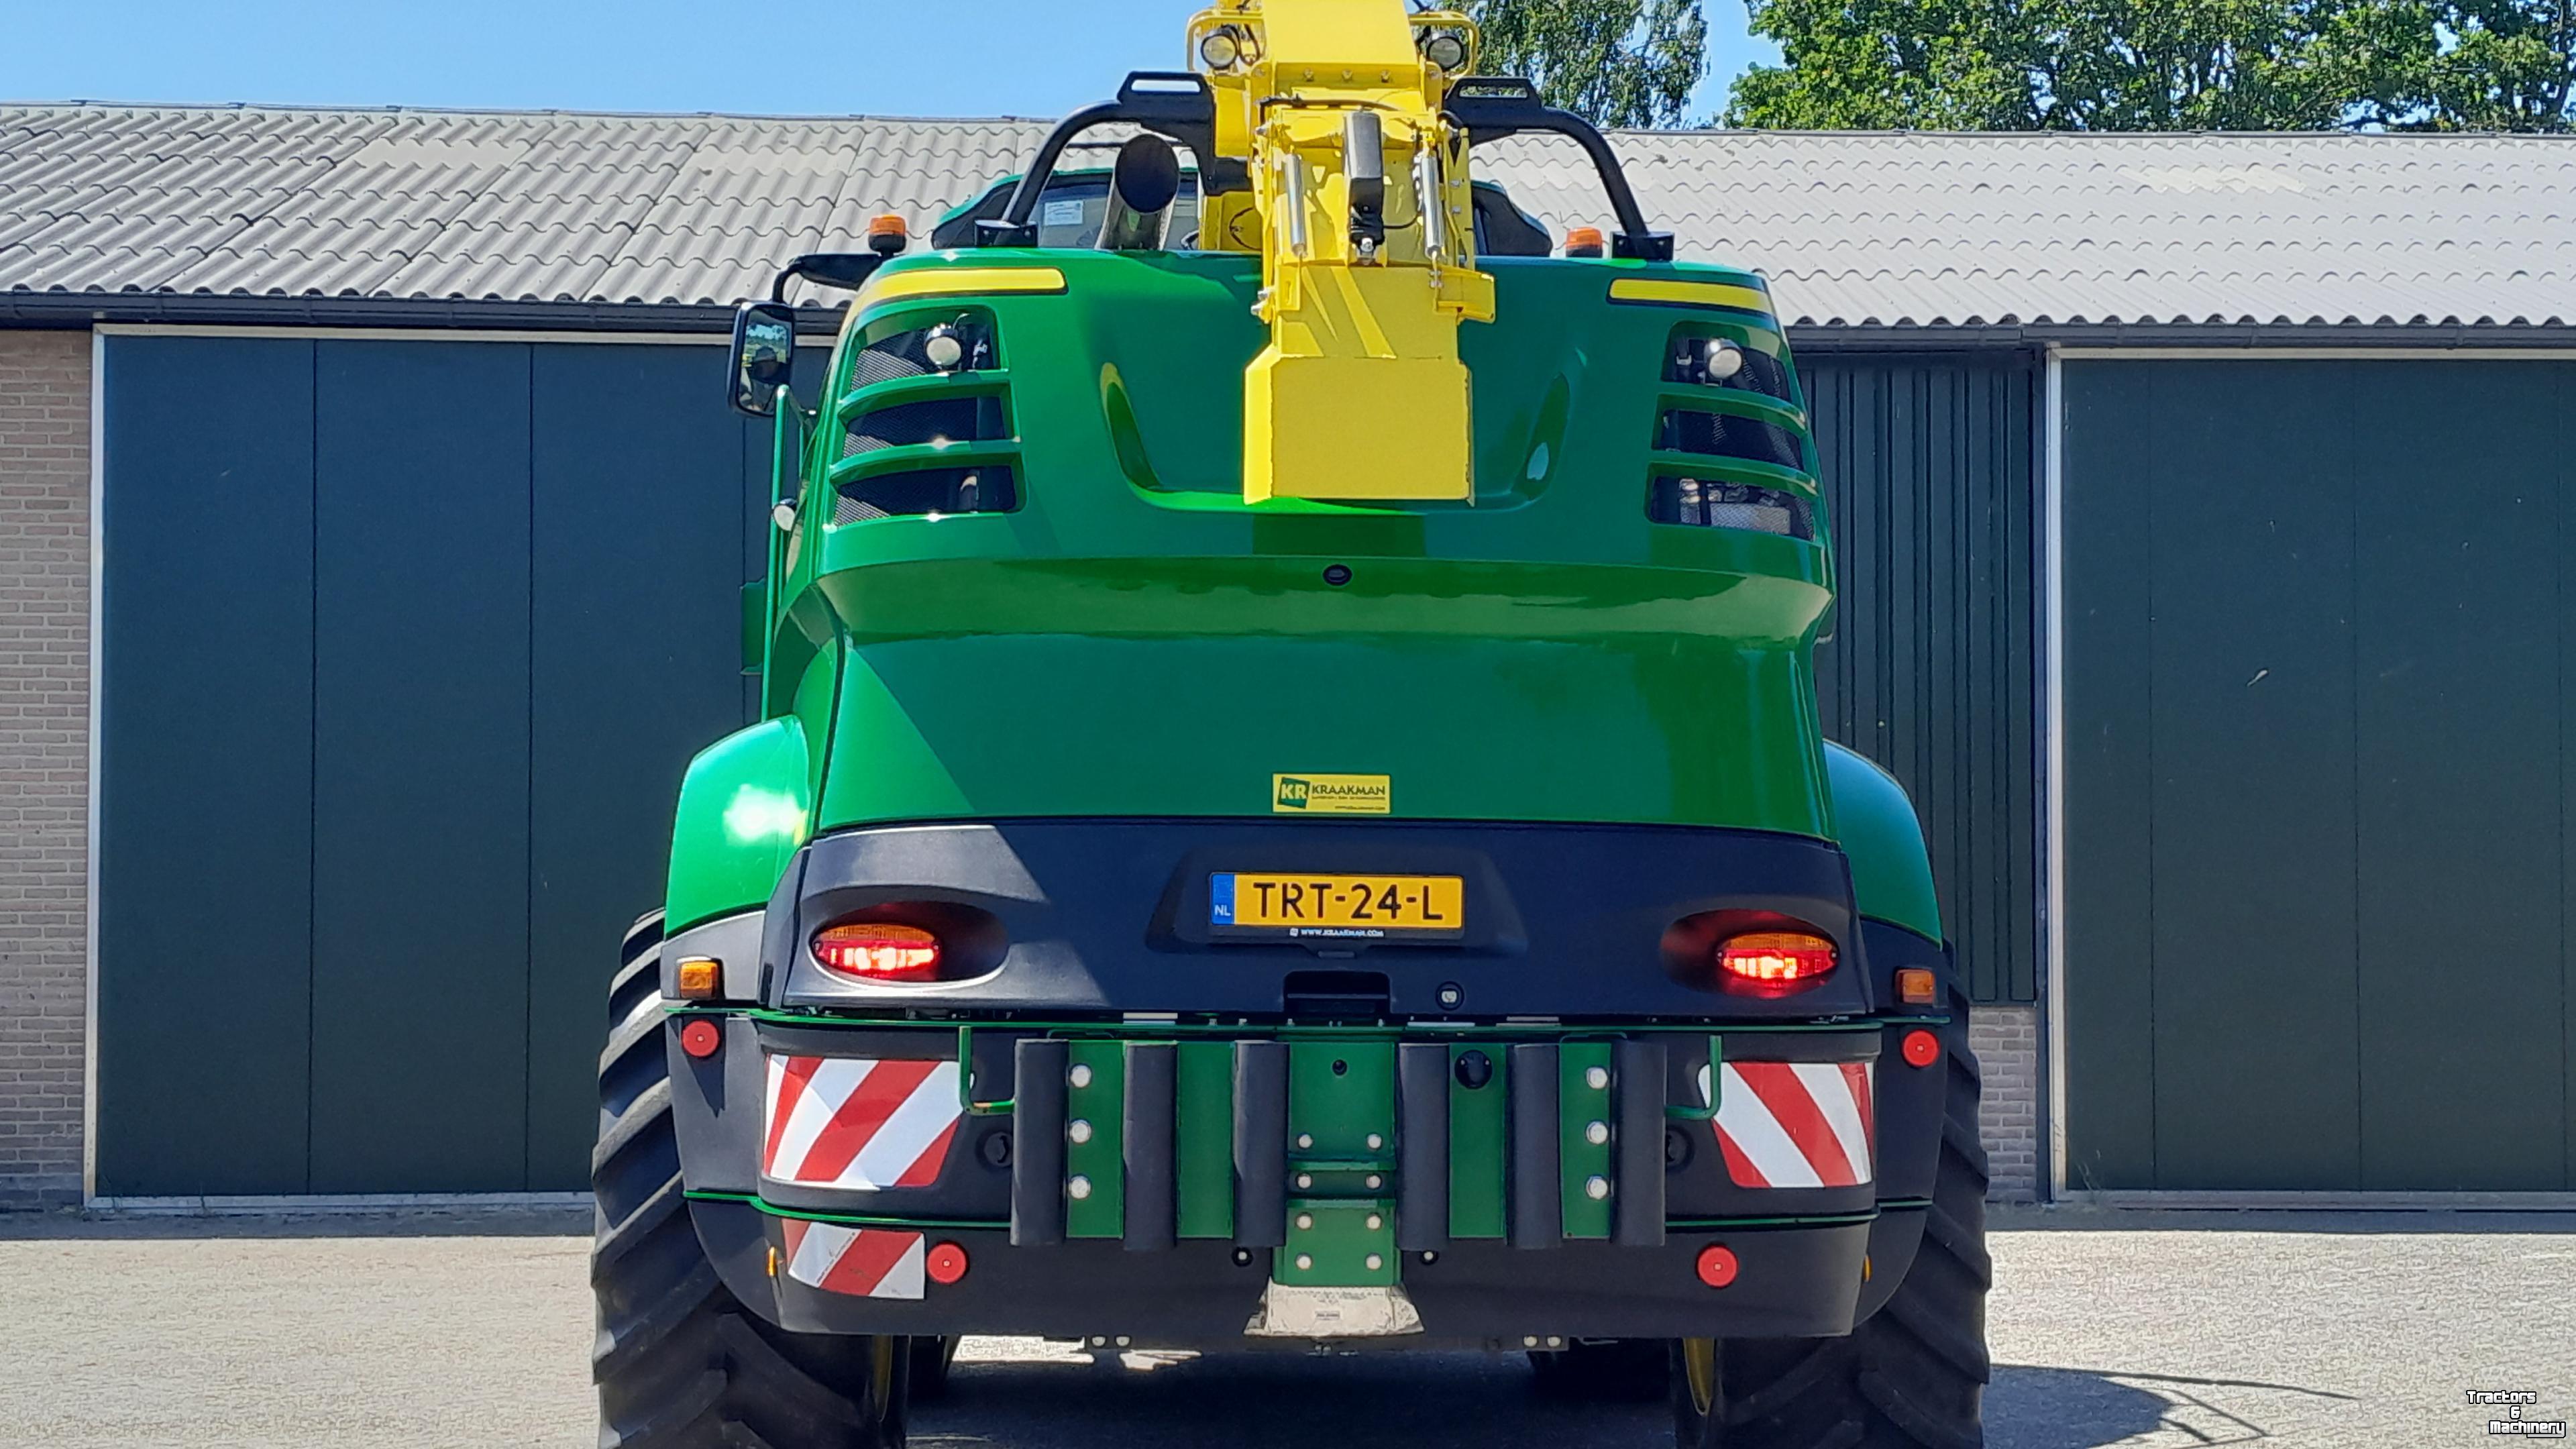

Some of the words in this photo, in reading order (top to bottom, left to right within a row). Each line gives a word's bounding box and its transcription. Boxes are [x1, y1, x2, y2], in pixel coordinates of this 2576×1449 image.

[1281, 784, 1307, 799] KR
[1311, 784, 1385, 796] KRAAKMAN
[1253, 881, 1443, 920] TRT-24-L
[1214, 904, 1232, 916] NL
